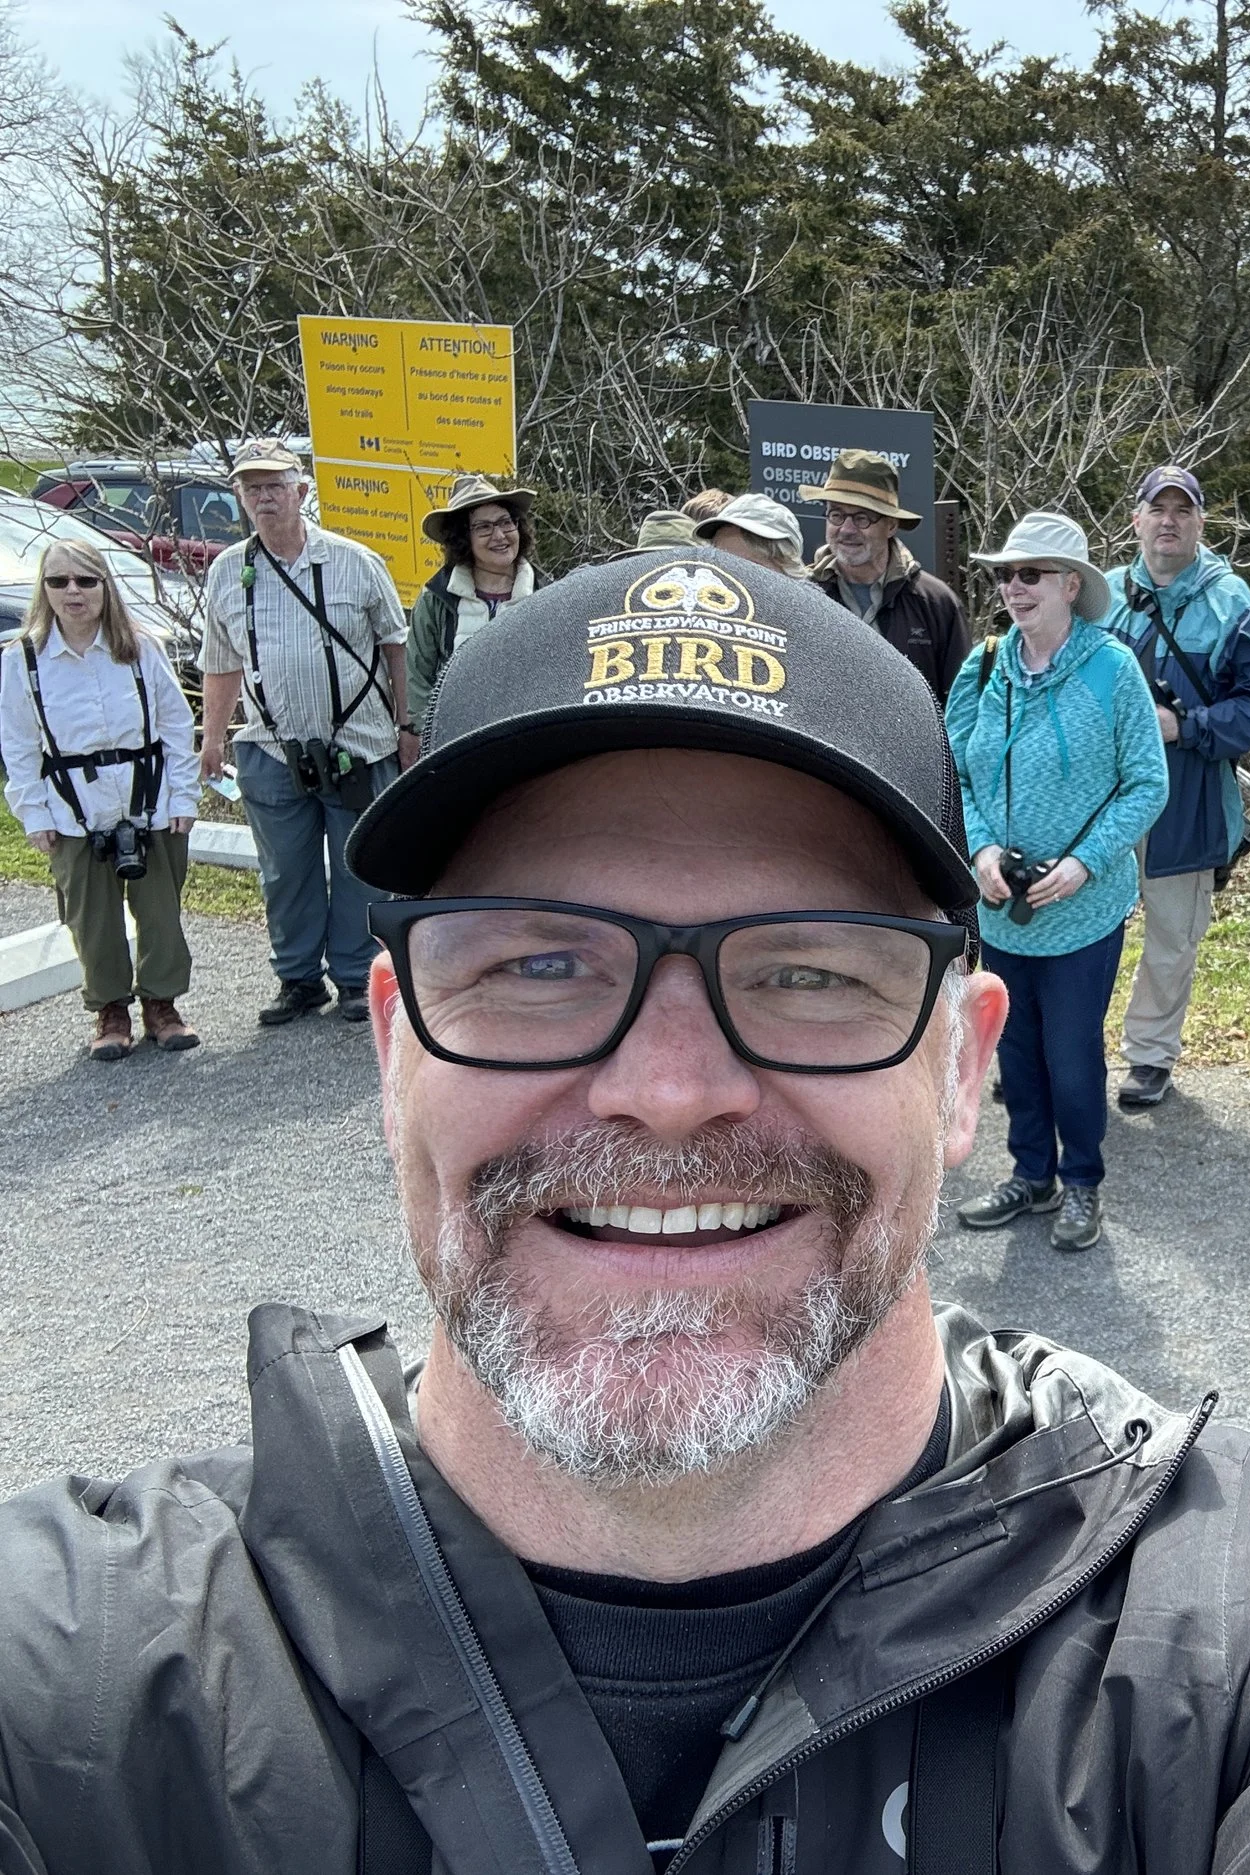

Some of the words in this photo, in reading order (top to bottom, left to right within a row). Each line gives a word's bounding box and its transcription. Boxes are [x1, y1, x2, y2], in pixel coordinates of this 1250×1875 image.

[321, 332, 379, 348] WARNING
[420, 337, 496, 355] ATTENTION!
[320, 361, 345, 371] Poison
[360, 365, 385, 375] occurs
[348, 387, 384, 399] roadways
[762, 441, 797, 458] BIRD
[800, 445, 910, 468] OBSEORY
[335, 475, 390, 494] WARNING
[426, 484, 451, 500] ATTE
[323, 502, 341, 513] Ticks
[342, 505, 369, 517] capable
[370, 508, 378, 516] of
[379, 511, 408, 523] carrying
[387, 531, 408, 543] found
[588, 617, 651, 638] PRINCE
[735, 625, 788, 647] POINT
[584, 637, 786, 694] BIRD
[583, 683, 789, 717] OBSERVATORY
